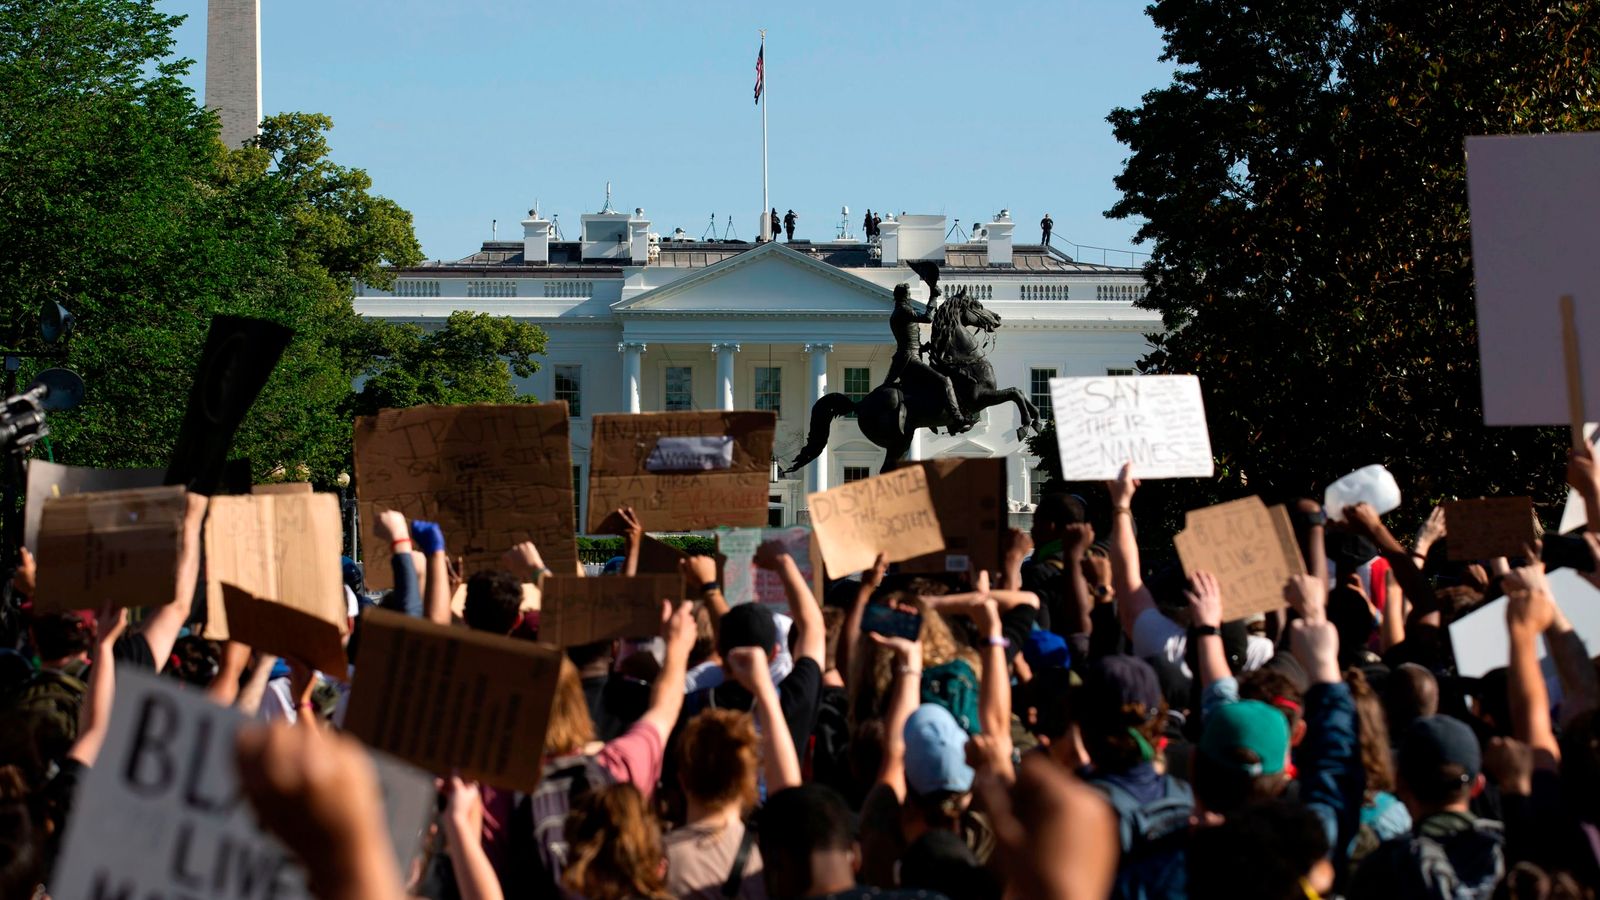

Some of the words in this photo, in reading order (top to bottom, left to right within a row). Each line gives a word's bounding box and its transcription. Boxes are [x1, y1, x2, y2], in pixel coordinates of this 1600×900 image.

[1082, 379, 1139, 415] SAY
[389, 408, 545, 460] TRUTH
[1081, 414, 1152, 437] THEIR
[1099, 437, 1184, 468] NAMES
[811, 469, 926, 524] DISMANTLE
[851, 506, 877, 528] THE
